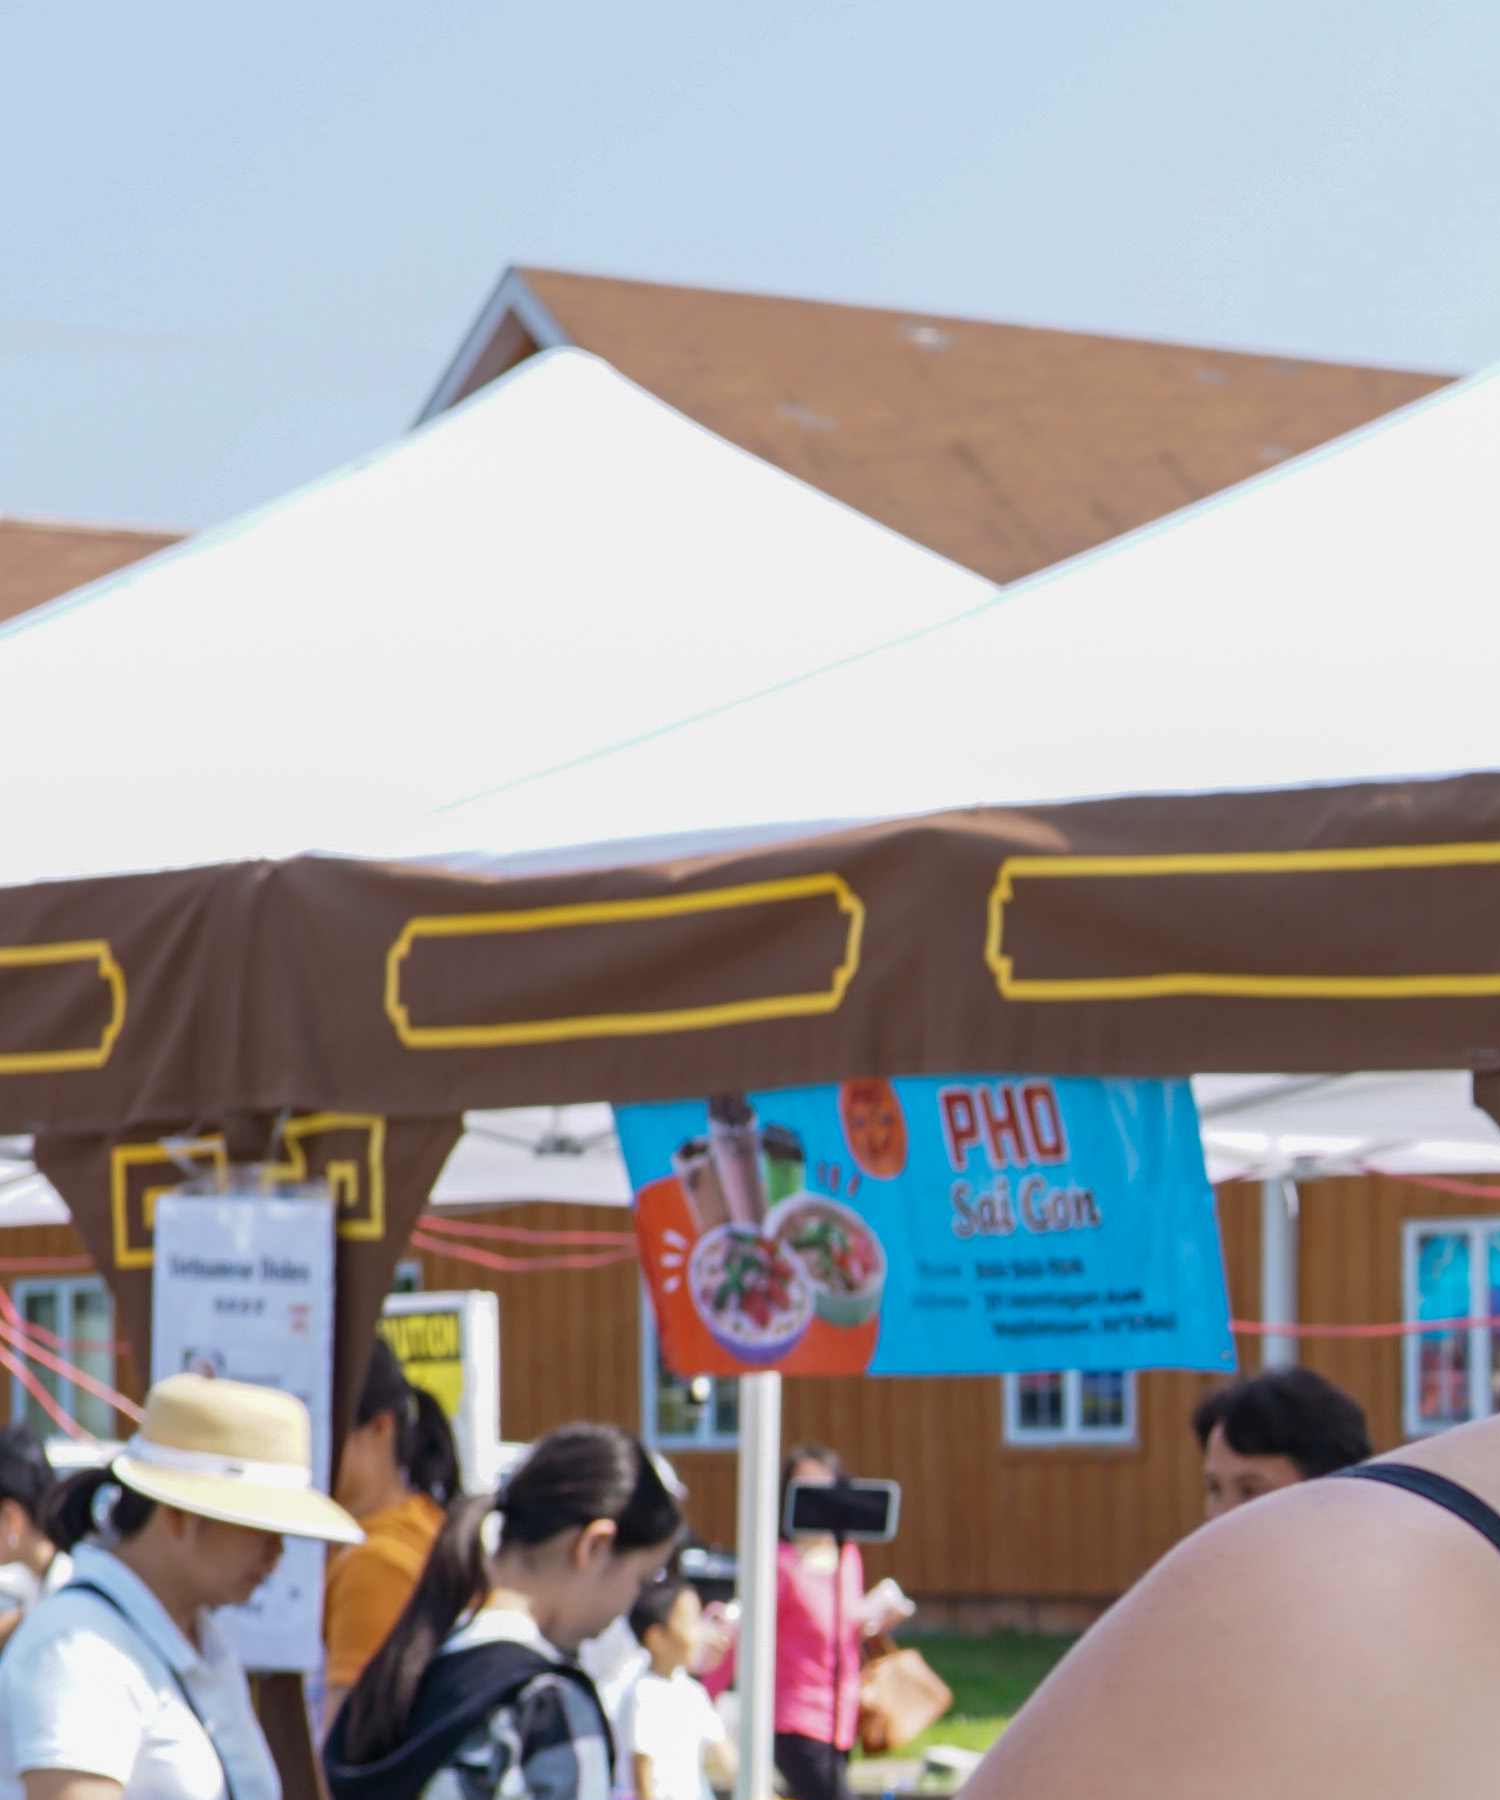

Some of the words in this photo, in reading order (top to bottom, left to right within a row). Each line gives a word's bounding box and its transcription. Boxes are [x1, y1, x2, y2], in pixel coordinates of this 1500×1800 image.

[941, 1080, 1068, 1171] PHO
[952, 1177, 1015, 1236] Sai
[1021, 1173, 1101, 1233] Gon
